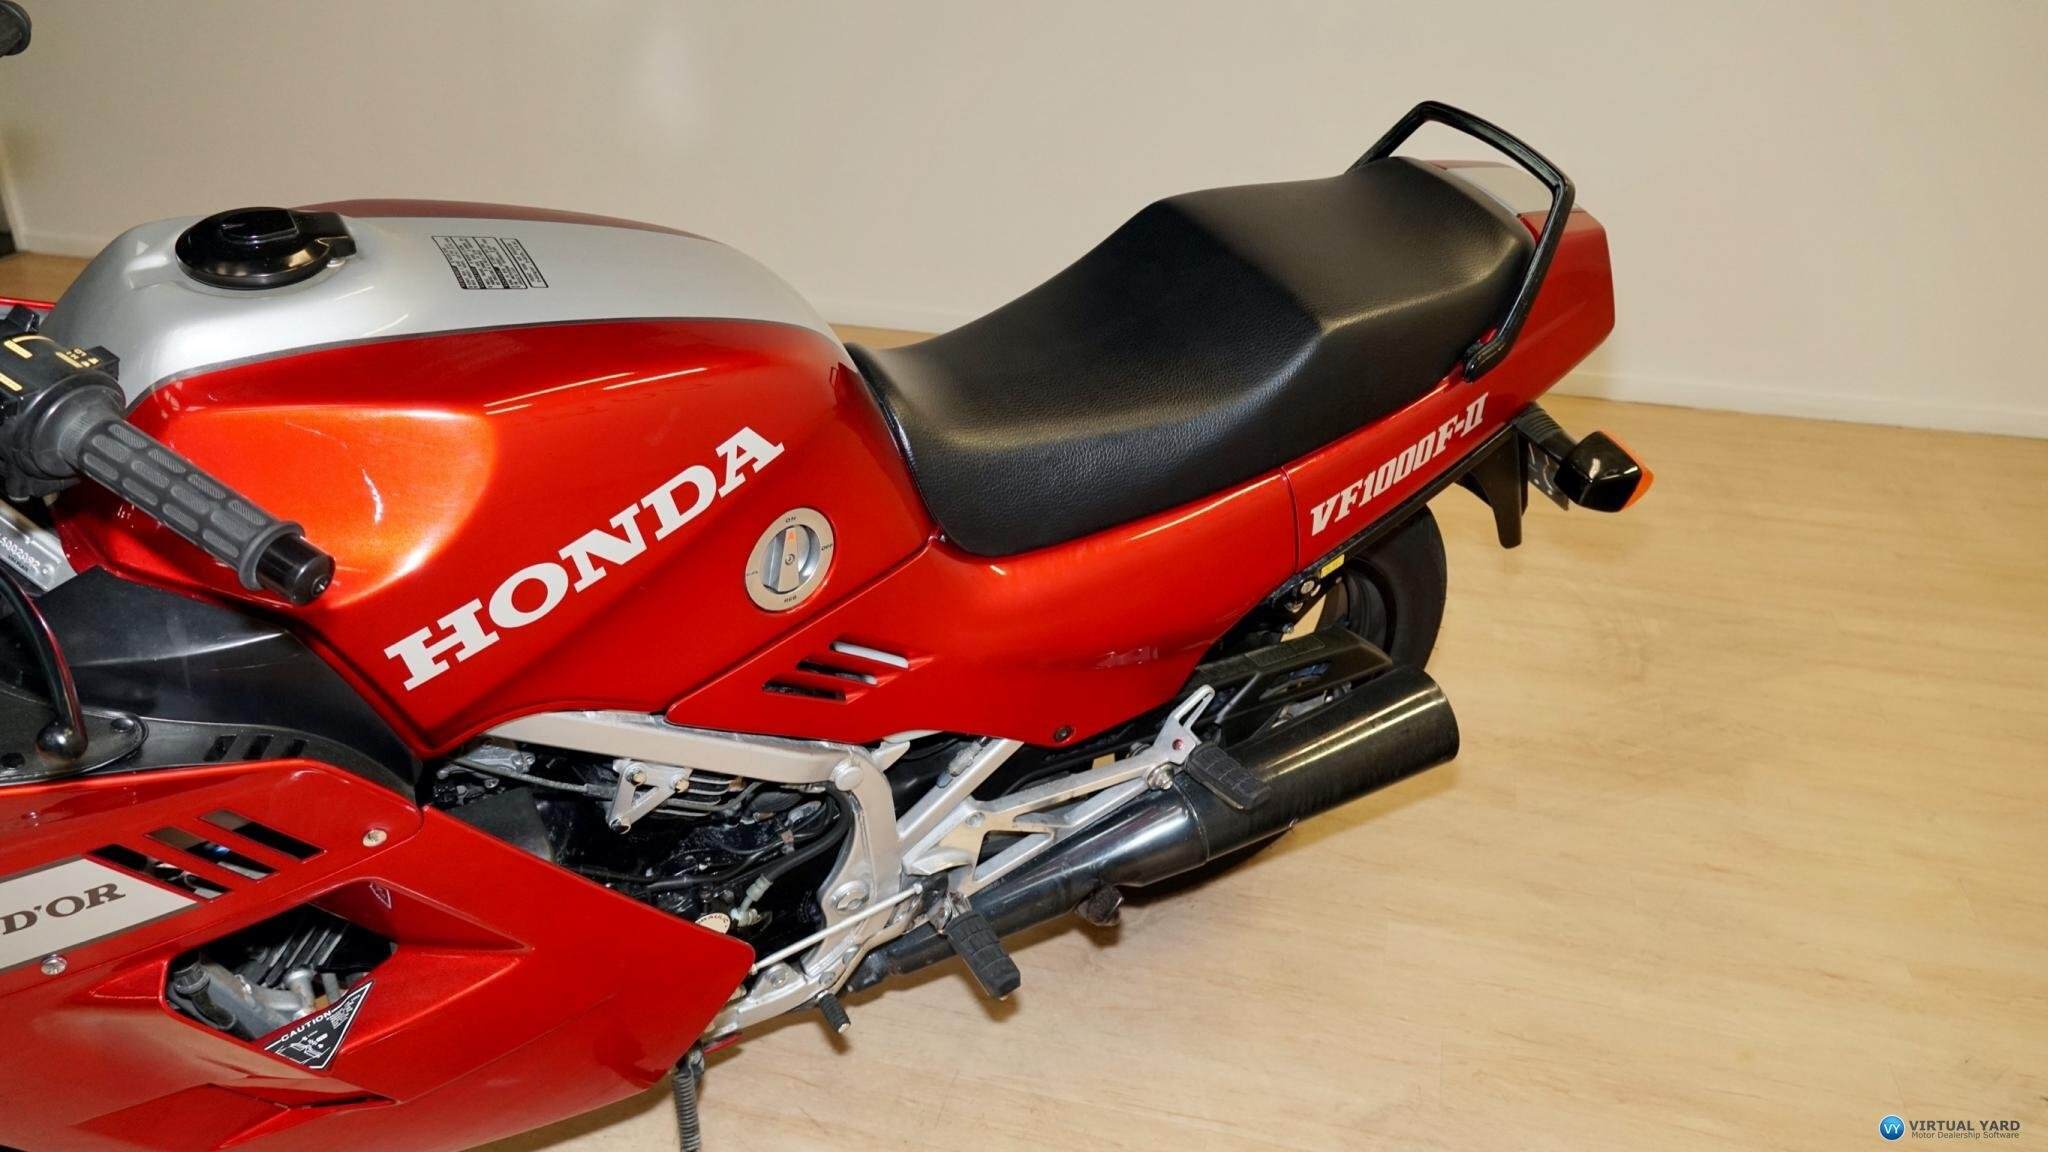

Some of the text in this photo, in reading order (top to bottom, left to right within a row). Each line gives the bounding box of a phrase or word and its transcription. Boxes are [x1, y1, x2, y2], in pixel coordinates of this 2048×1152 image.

[384, 426, 785, 691] HONDA
[0, 883, 126, 935] D'OR
[281, 1010, 332, 1042] CAUTION
